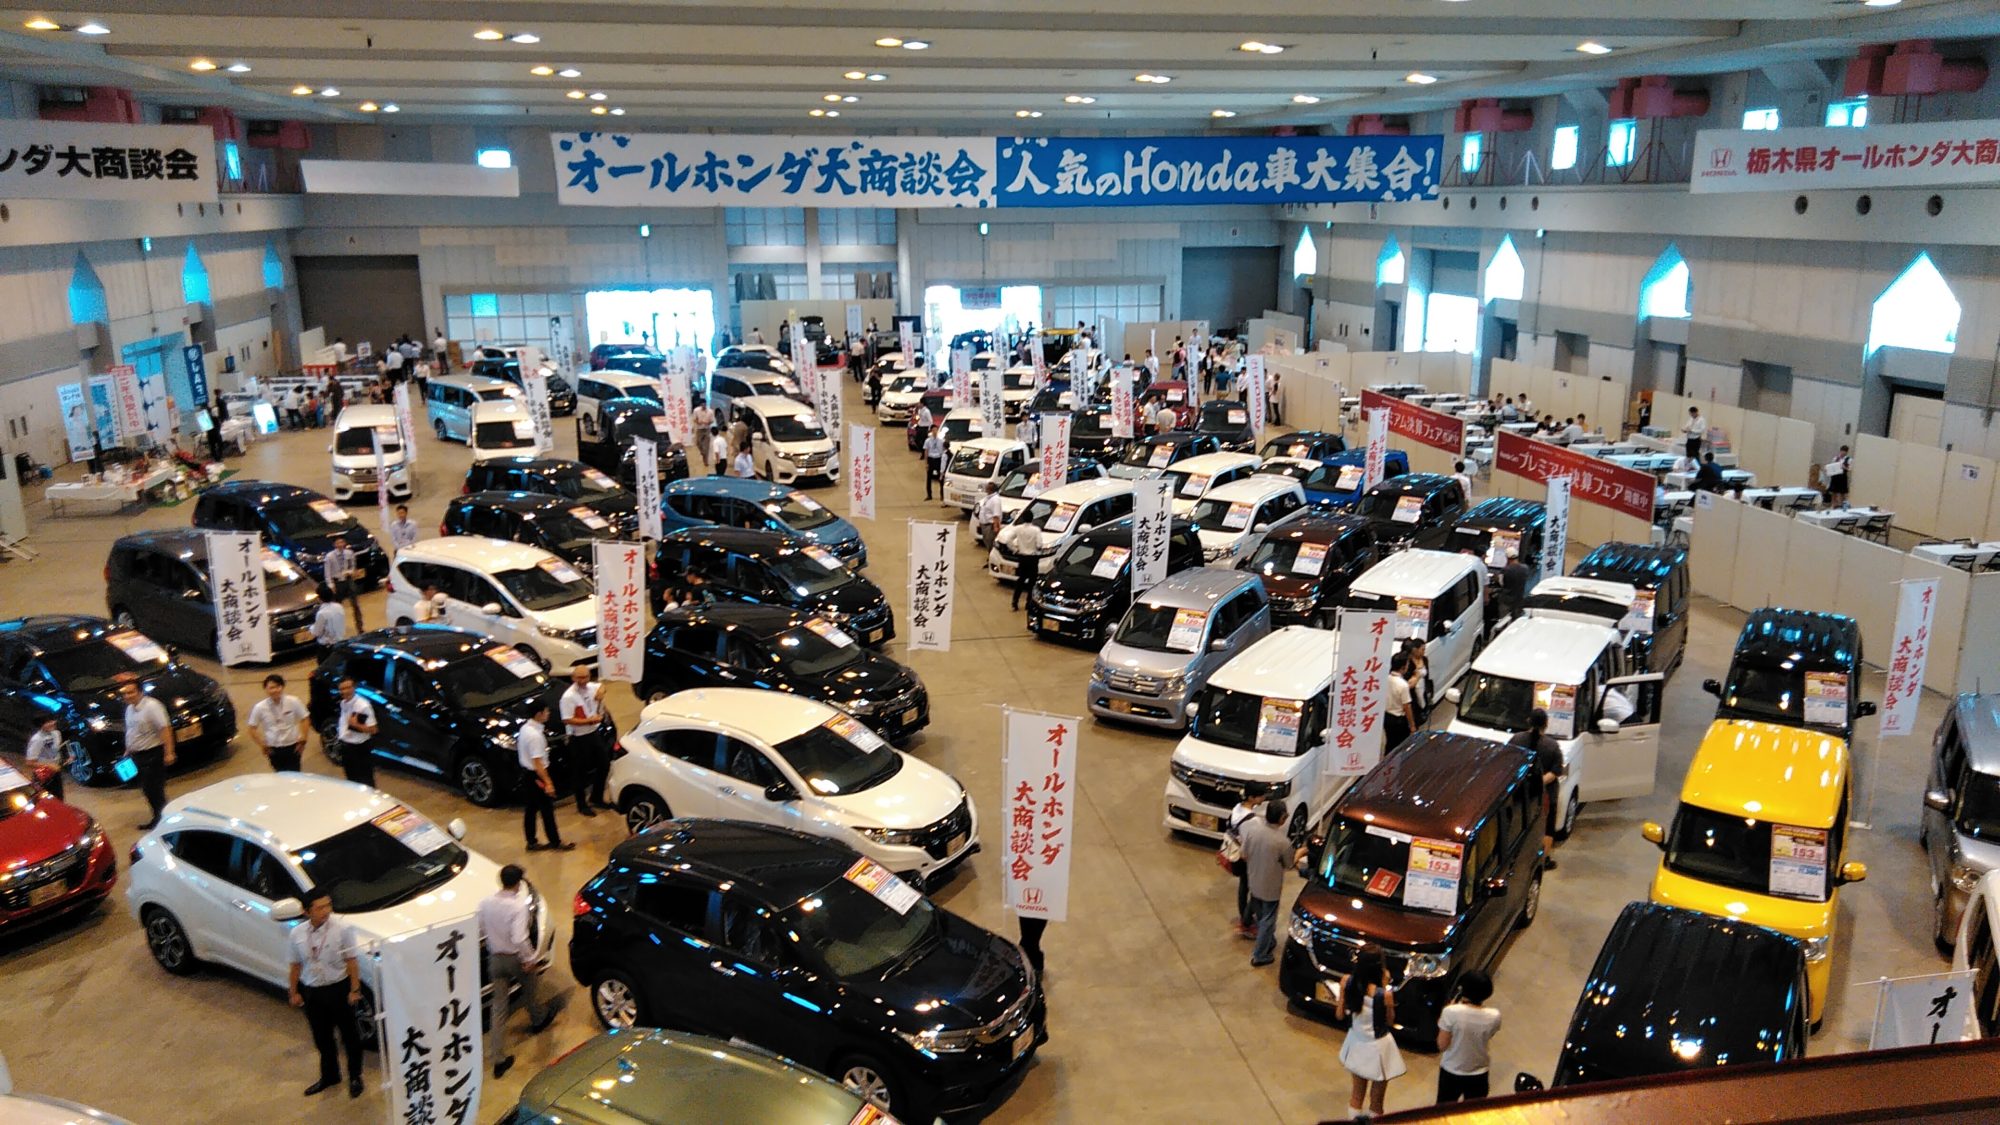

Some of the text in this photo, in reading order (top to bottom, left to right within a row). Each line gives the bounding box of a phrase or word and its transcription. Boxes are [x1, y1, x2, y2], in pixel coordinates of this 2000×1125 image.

[567, 147, 987, 196] オールホンダ大商談会
[1746, 137, 2000, 175] 栃木県オールホンダ大商
[1136, 516, 1152, 571] 大商談会
[1151, 482, 1168, 562] オールホンダ
[220, 578, 243, 641] 大商談会
[239, 538, 262, 628] オールホンダ
[622, 549, 640, 648] オールホンダ
[914, 564, 931, 628] 大商談会
[934, 528, 950, 617] オールホンダ
[602, 589, 620, 659] 大商談会
[1905, 586, 1933, 698] オールホンダ
[1336, 665, 1359, 749] 大商談会
[1361, 616, 1389, 733] オールホンダ
[1885, 635, 1913, 711] 大商談会
[1010, 780, 1037, 882] 大商談会
[1040, 723, 1068, 866] オールホンダ
[434, 929, 477, 1125] オールホンダ
